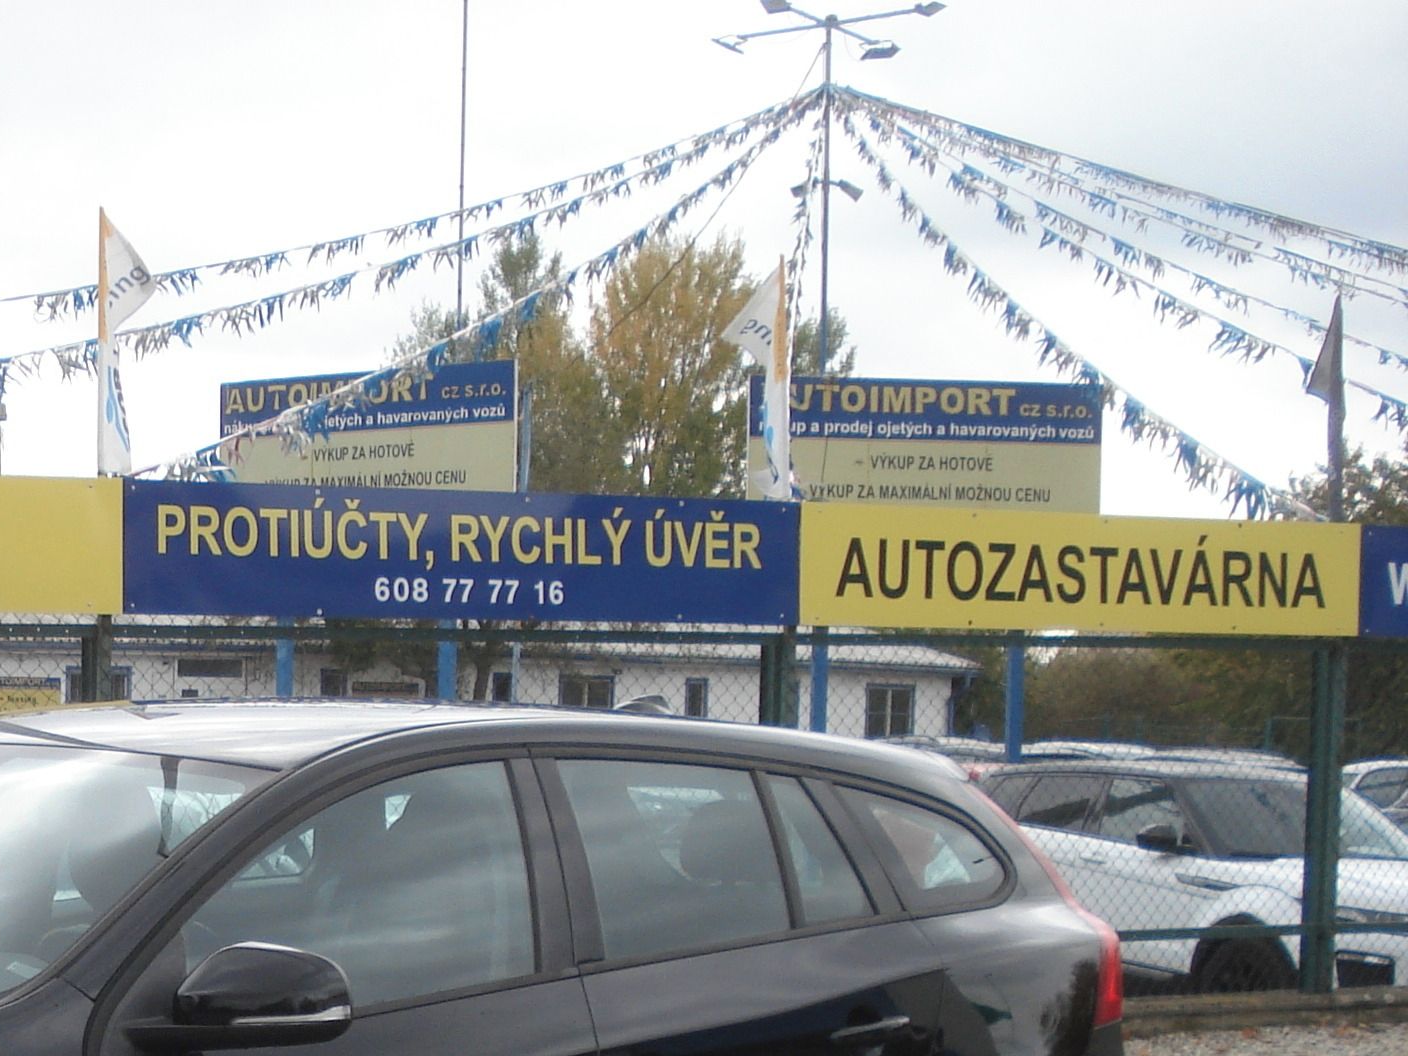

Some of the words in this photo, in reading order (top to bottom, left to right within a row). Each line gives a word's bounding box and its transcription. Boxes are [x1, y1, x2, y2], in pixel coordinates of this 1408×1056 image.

[224, 373, 435, 415] AUTOIMORT
[464, 382, 507, 398] s.r.o.
[790, 384, 1017, 417] UTOIMPORT
[1019, 403, 1041, 418] cz
[1046, 403, 1093, 418] s.r.o.
[365, 414, 374, 425] a
[377, 406, 469, 425] havarovaných
[810, 421, 820, 432] a
[824, 420, 873, 436] prodej
[877, 421, 933, 437] ojetých
[936, 425, 946, 436] a
[950, 423, 1056, 440] havarovaných
[352, 446, 366, 461] ZA
[368, 442, 415, 460] HOTOVÉ
[918, 456, 936, 471] ZA
[384, 469, 433, 487] MOŽNOU
[436, 470, 467, 484] CENU
[857, 485, 876, 499] ZA
[955, 484, 1012, 502] MOŽNOU
[1015, 487, 1051, 502] CENU
[157, 497, 436, 571] PROTIÚČTY,
[450, 507, 632, 567] RYCHLÝ
[645, 508, 763, 569] ÚVĚR
[835, 535, 1327, 609] AUTOZASTAVÁRNA
[374, 576, 429, 603] 608
[442, 578, 475, 604] 77
[488, 579, 520, 605] 77
[534, 580, 565, 605] 16
